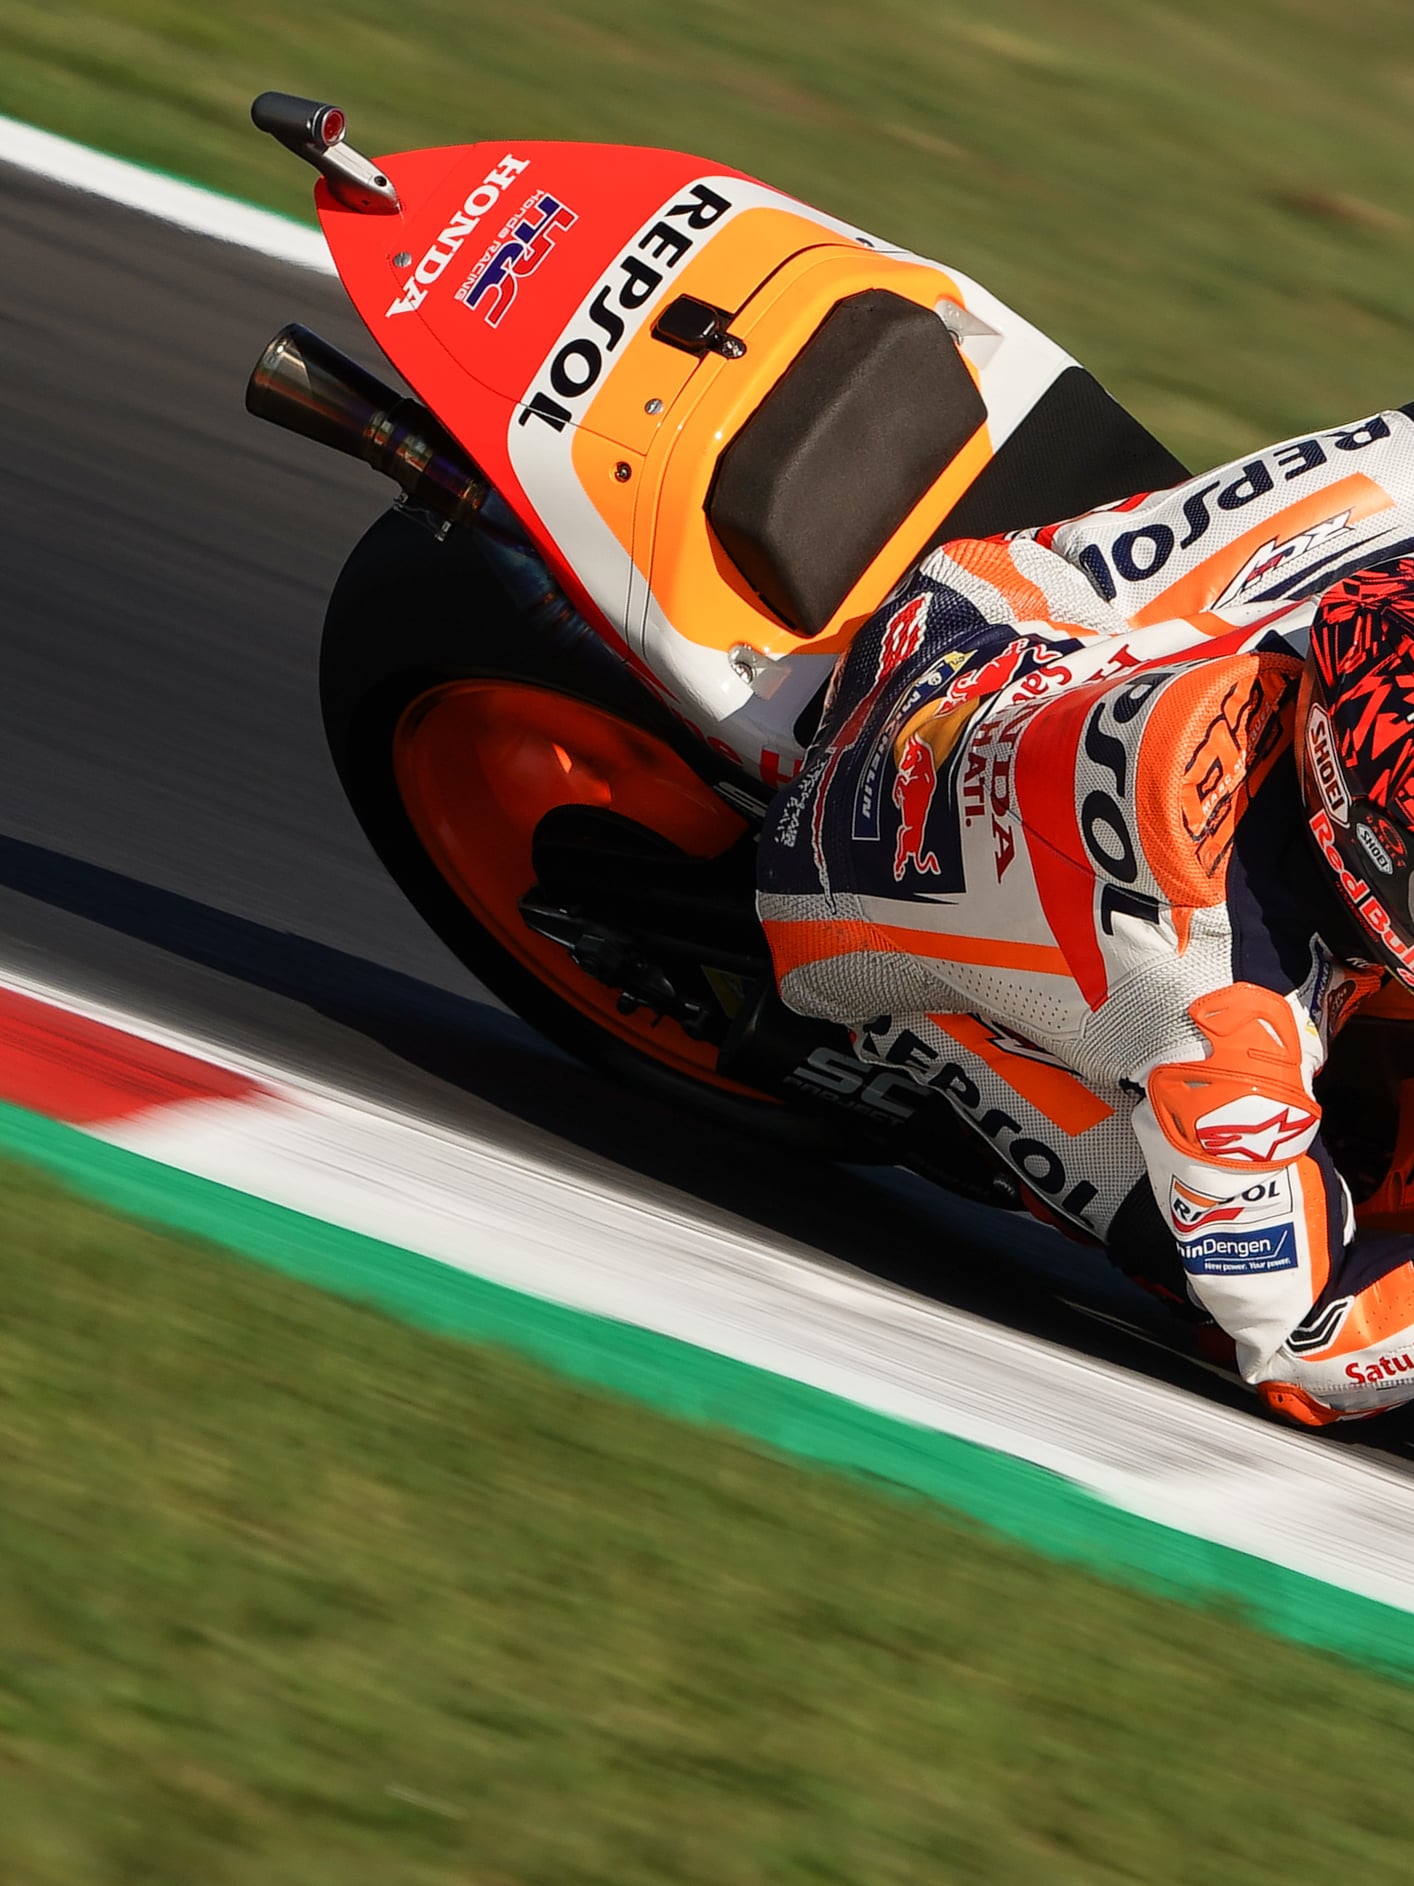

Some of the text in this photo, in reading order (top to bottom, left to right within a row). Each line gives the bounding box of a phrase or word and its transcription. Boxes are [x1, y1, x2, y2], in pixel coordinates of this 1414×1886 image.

[385, 153, 531, 318] HONDA
[454, 240, 502, 301] RACING
[518, 184, 732, 433] REPSOL
[1079, 416, 1392, 603] REPSOL
[1310, 720, 1345, 812] SHOEI
[1309, 808, 1371, 904] Red
[1360, 830, 1388, 868] SHOEI
